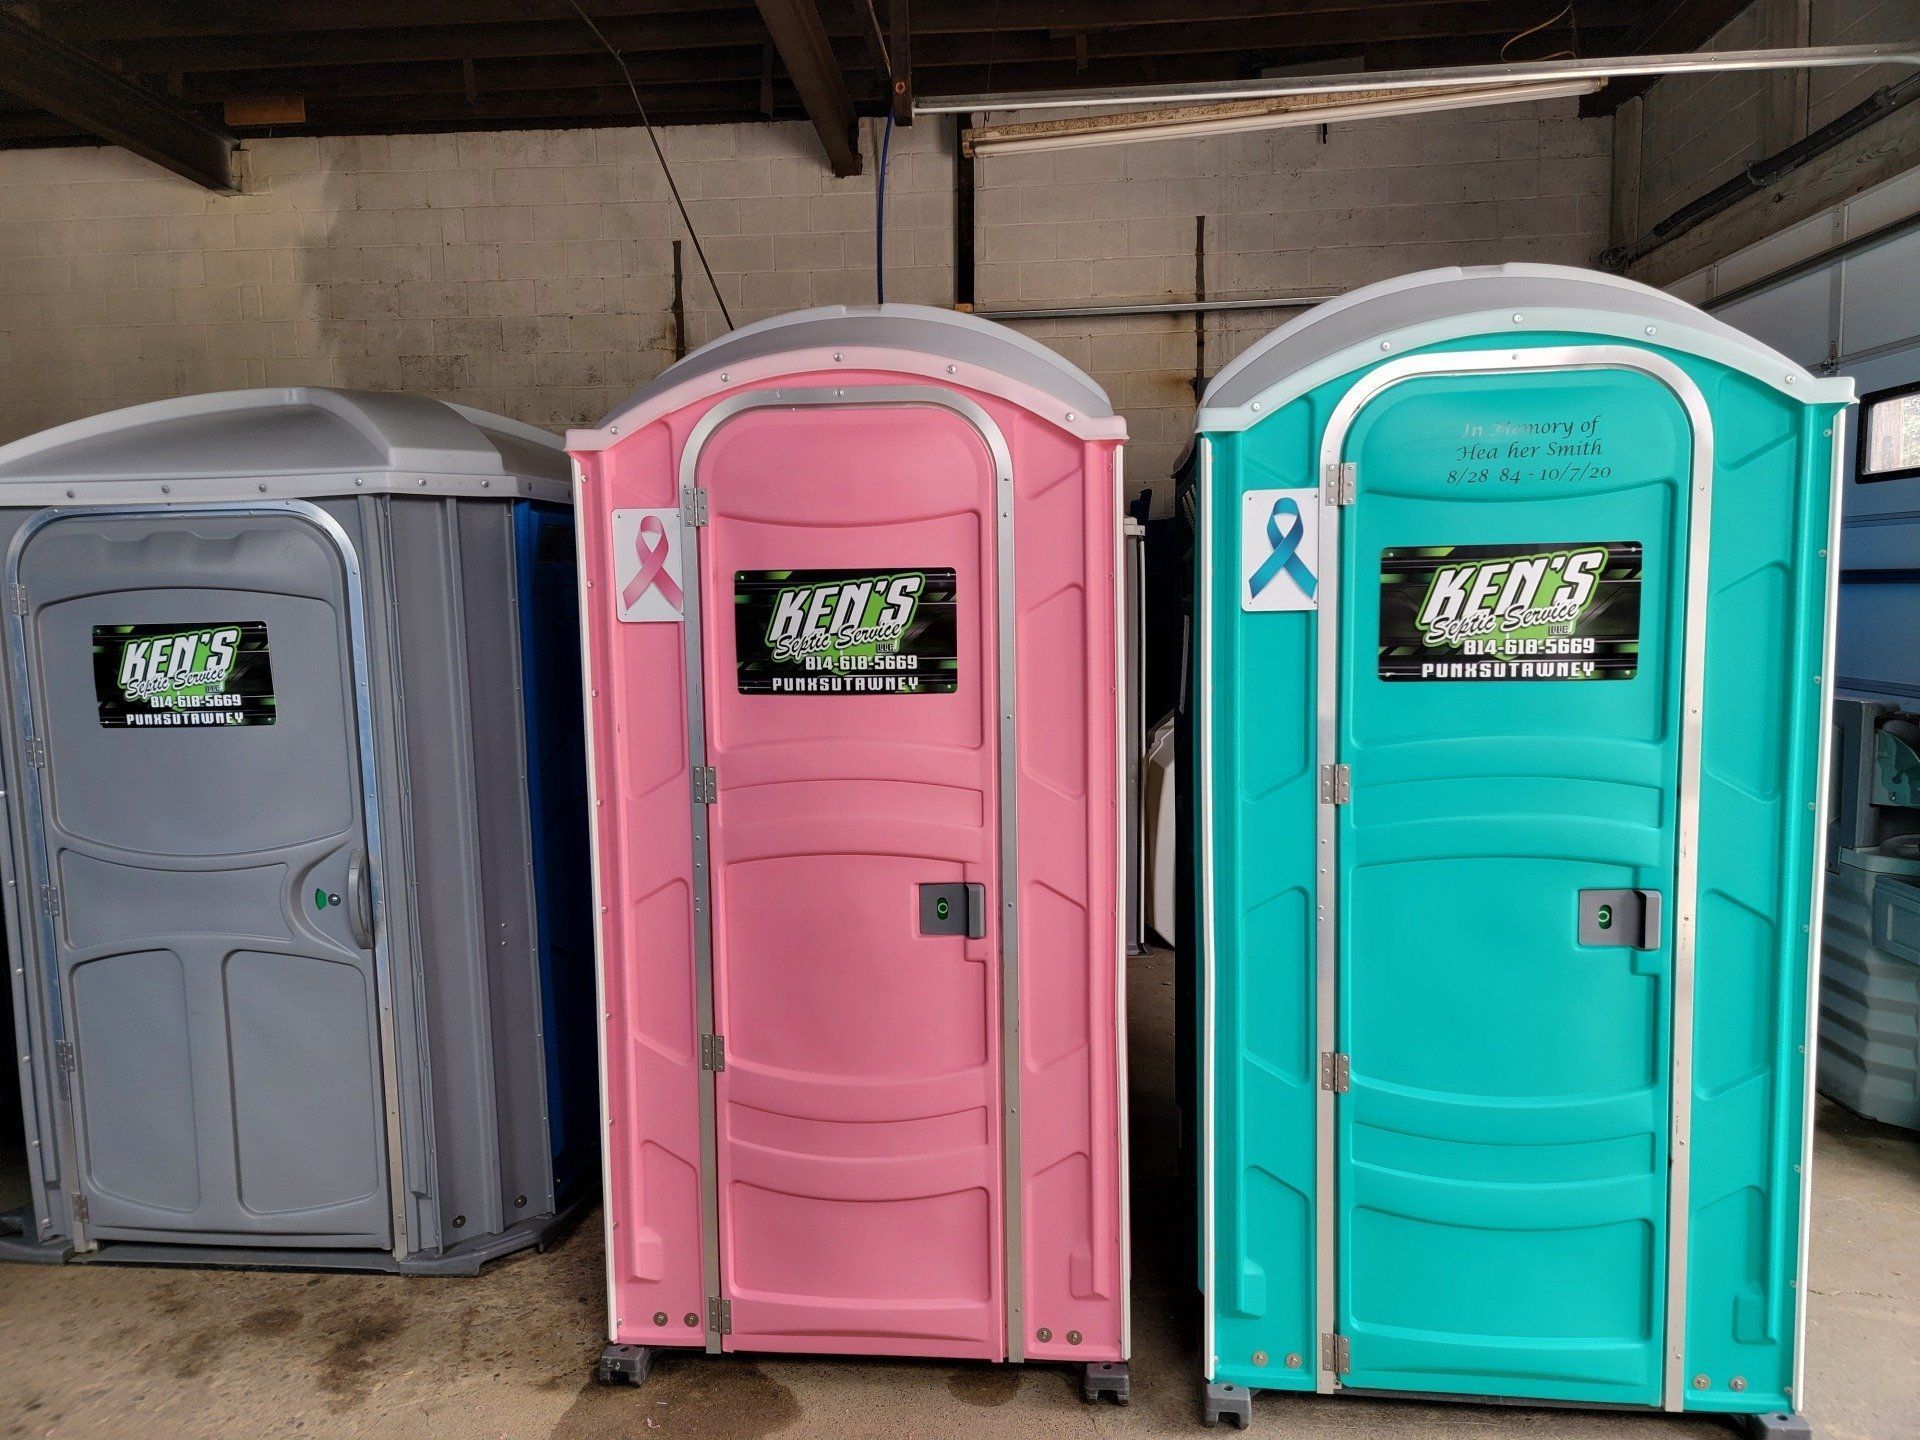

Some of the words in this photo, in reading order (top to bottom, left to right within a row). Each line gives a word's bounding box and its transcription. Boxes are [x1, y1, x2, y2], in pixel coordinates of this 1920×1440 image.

[1580, 414, 1602, 438] of
[1546, 438, 1604, 456] Smith
[1539, 461, 1611, 482] 10/7/20
[1421, 552, 1603, 624] KEN'S
[769, 576, 921, 641] KEN'S
[1427, 613, 1496, 644] Septic
[1501, 600, 1579, 632] Service
[773, 631, 830, 661] Septic
[835, 622, 902, 649] Service
[1463, 638, 1595, 655] 814-618-5669
[120, 629, 239, 684] KEN'S
[805, 655, 918, 670] 814-618-5669
[1421, 662, 1595, 679] PUNXSUTAWNEY
[125, 673, 170, 701] Septic
[173, 666, 226, 690] Service
[772, 677, 919, 692] PUNXSUTAWNEY
[150, 694, 242, 708] 814-618-5669
[126, 712, 244, 726] PUNXSUTAWNEY
